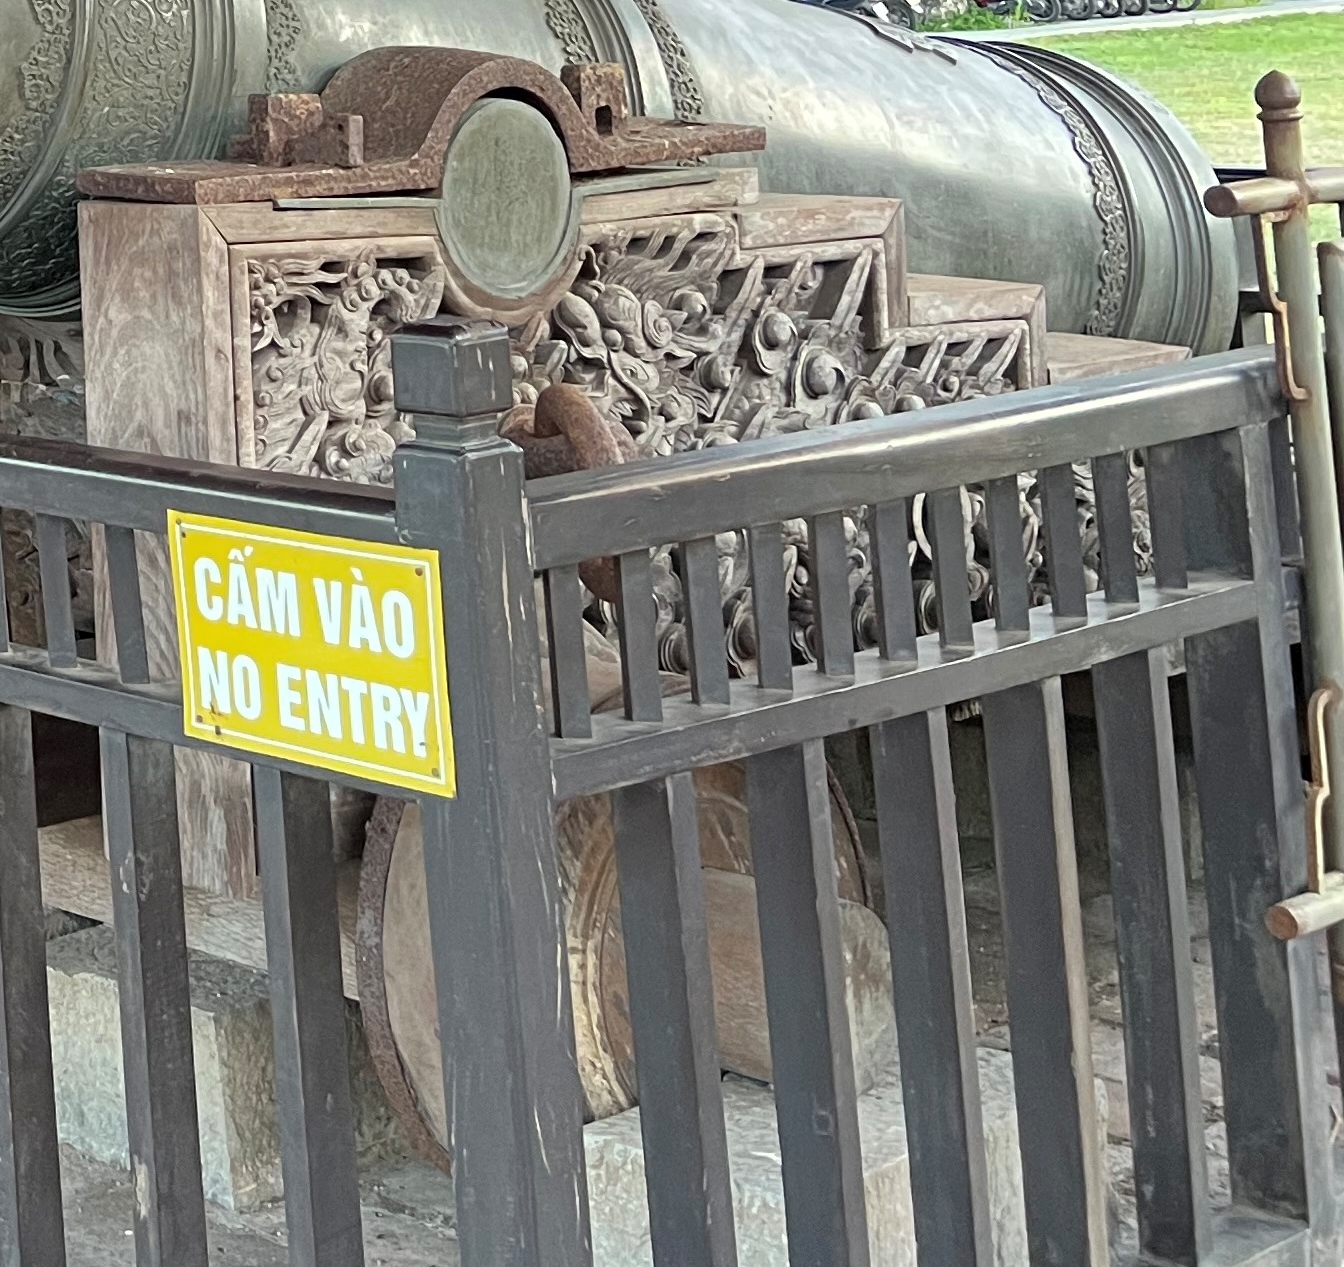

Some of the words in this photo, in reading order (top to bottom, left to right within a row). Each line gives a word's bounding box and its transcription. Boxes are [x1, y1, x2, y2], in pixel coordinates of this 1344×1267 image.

[193, 546, 301, 638] CẤM
[313, 567, 415, 659] VÀO
[197, 646, 262, 721] NO
[276, 662, 429, 759] ENTRY
